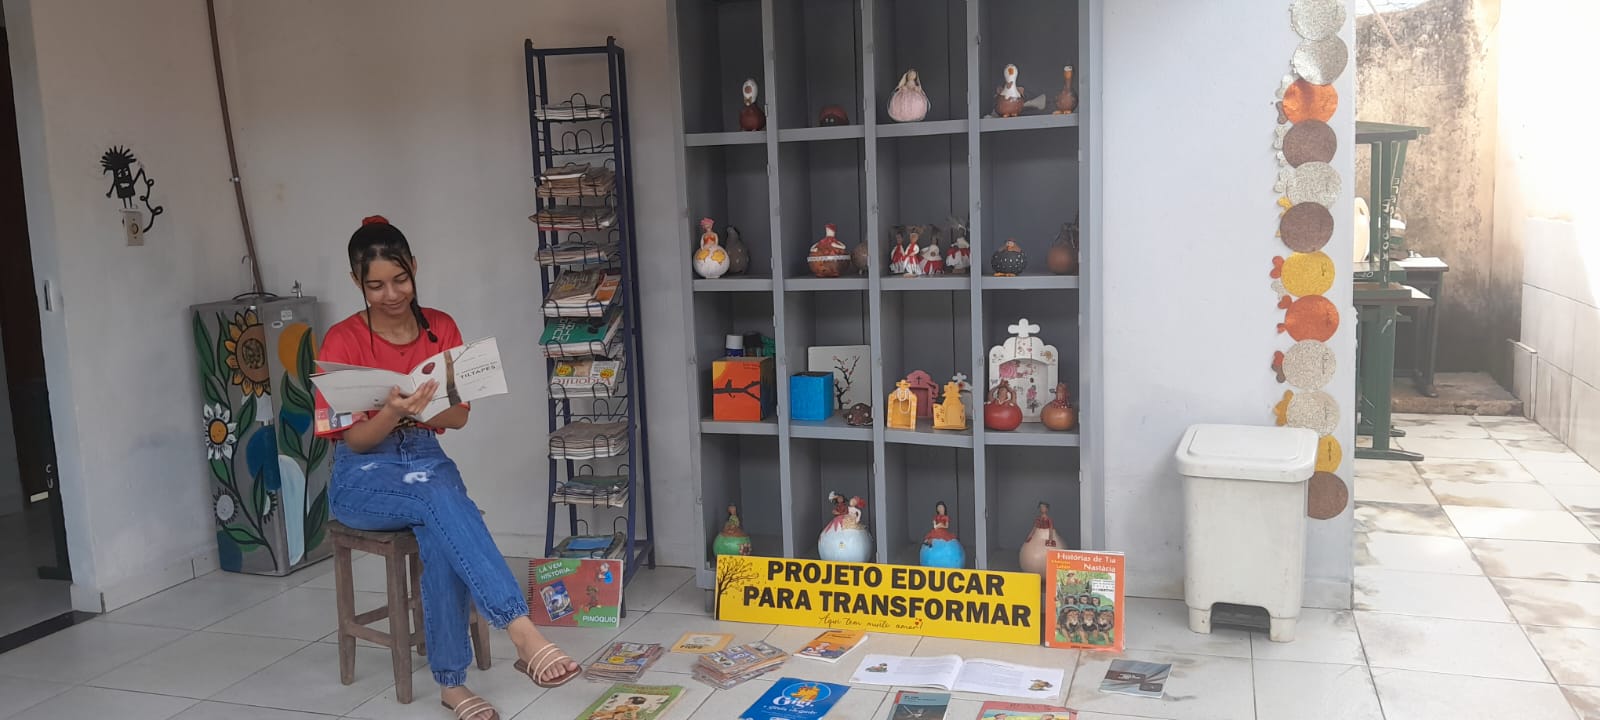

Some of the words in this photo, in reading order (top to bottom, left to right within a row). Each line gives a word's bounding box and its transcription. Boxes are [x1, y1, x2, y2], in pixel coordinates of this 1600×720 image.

[1057, 552, 1091, 562] Histórias
[1105, 556, 1116, 564] Tia
[548, 562, 562, 570] VEM
[1083, 563, 1116, 573] Nastácia
[767, 560, 883, 587] PROJETO
[891, 568, 1005, 597] EDUCAR
[743, 586, 812, 610] PARA
[819, 590, 1031, 628] TRANSFORMAR
[582, 615, 617, 624] PINÓQUIO
[819, 612, 840, 629] Aqui
